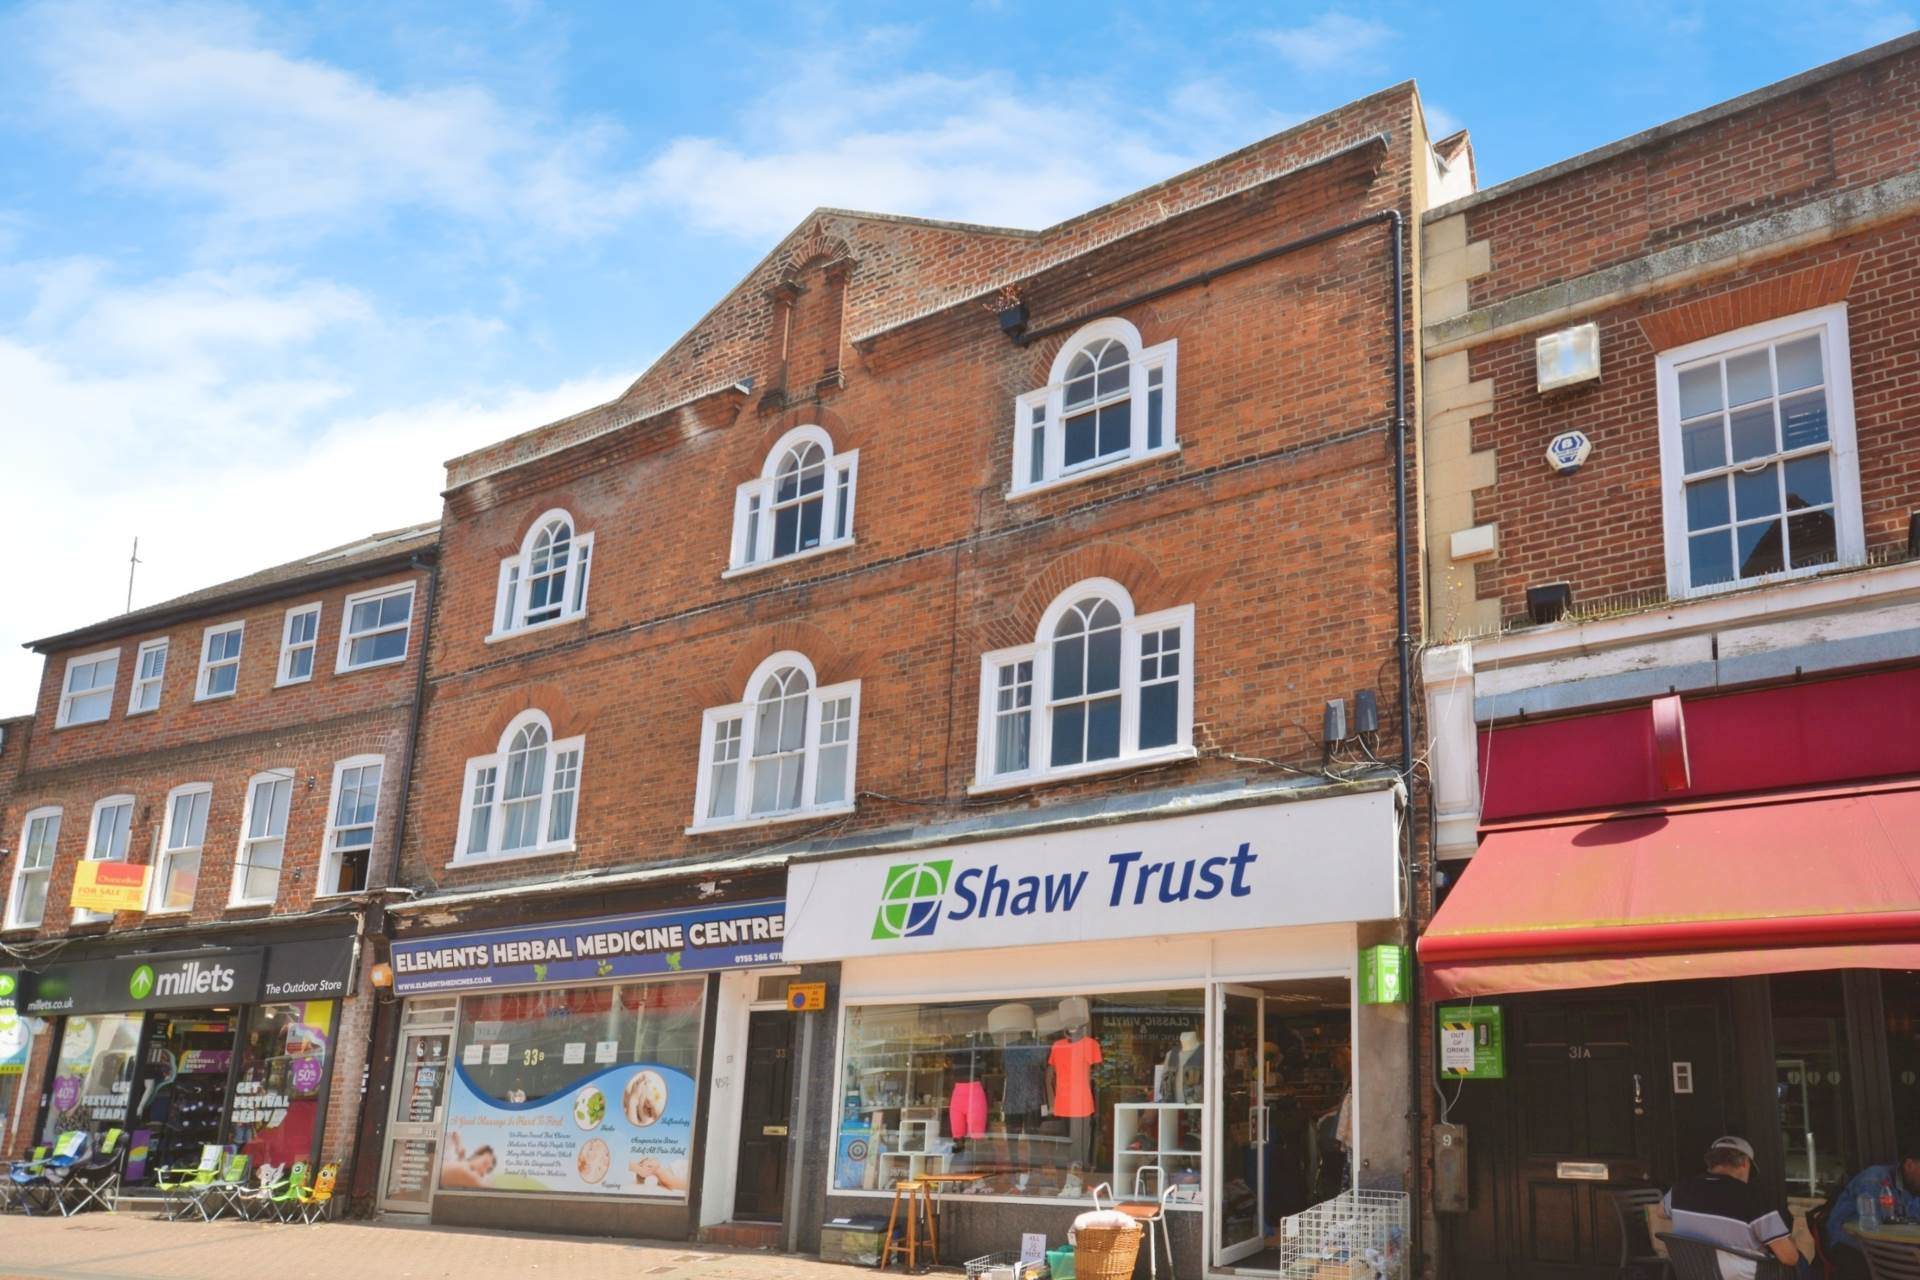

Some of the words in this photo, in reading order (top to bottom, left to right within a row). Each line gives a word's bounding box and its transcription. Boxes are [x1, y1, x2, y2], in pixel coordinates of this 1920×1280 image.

[947, 864, 1088, 921] Shaw
[1108, 842, 1258, 907] Trust
[78, 887, 96, 896] FOR
[99, 889, 120, 897] SALE
[396, 945, 489, 973] ELEMENTS
[493, 937, 572, 964] HERBAL
[576, 925, 683, 957] MEDICINE
[689, 915, 783, 945] CENTRE
[156, 961, 235, 996] millets
[265, 983, 281, 995] The
[282, 981, 318, 993] Outdoor
[319, 979, 342, 991] Store
[27, 997, 73, 1010] millets.co.uk
[236, 1082, 260, 1094] GET
[233, 1095, 289, 1109] FESTIVAL
[1442, 1134, 1452, 1147] 9
